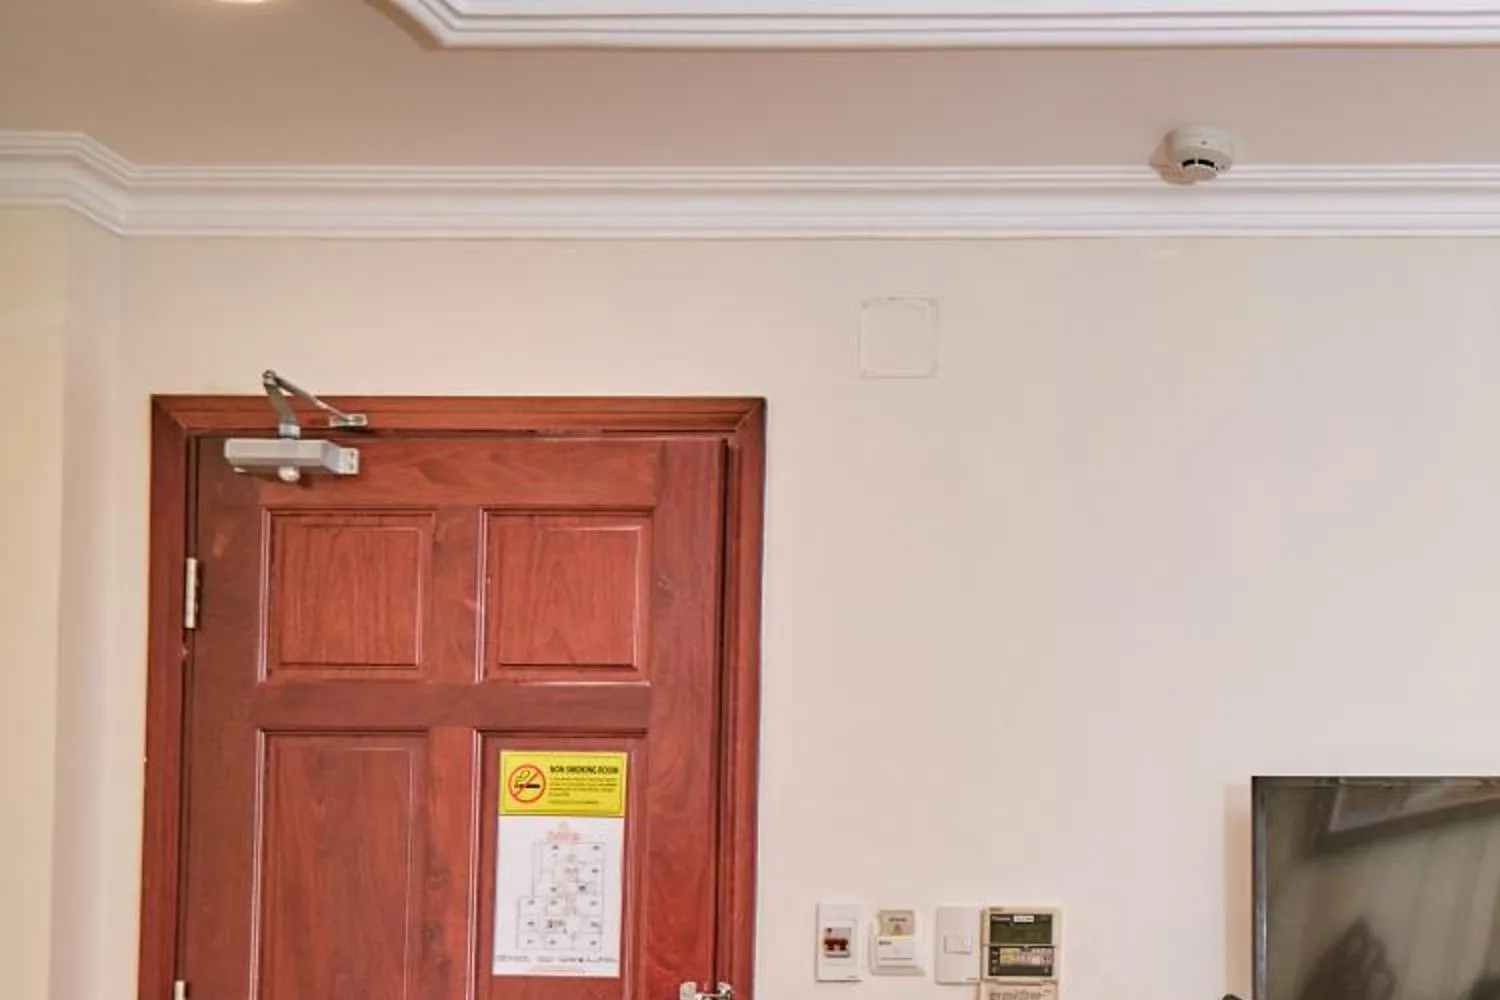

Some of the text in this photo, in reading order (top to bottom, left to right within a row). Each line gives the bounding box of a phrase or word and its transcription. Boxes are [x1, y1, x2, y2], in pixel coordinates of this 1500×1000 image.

[549, 765, 619, 775] NON SMOKING ROOM
